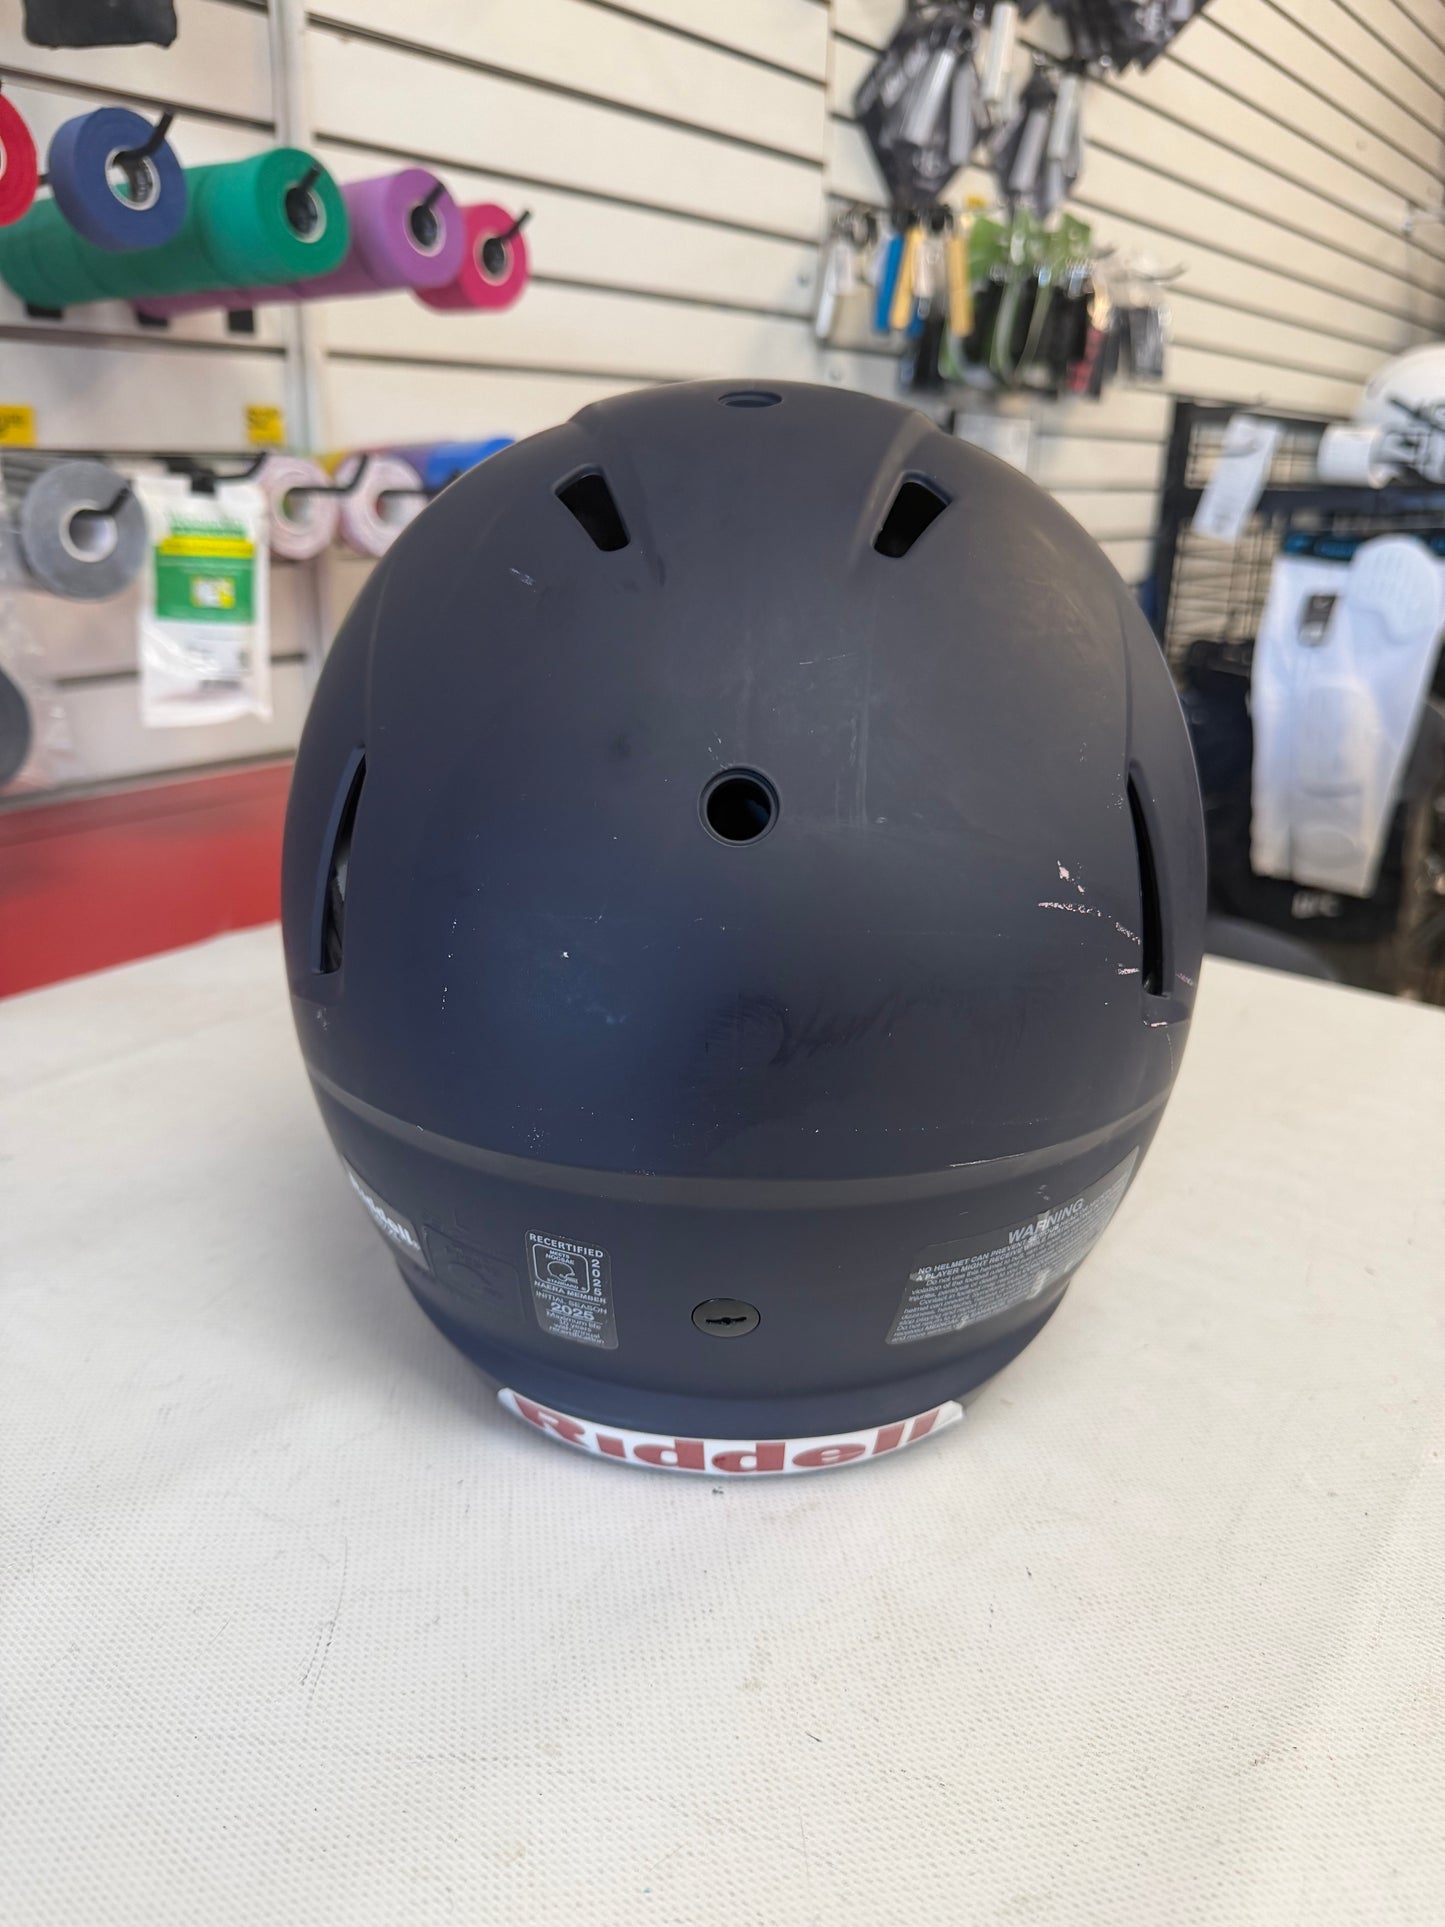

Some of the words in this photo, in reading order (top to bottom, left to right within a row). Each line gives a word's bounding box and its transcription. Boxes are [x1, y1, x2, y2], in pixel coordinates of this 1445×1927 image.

[1008, 1198, 1085, 1245] WARNING
[529, 1232, 604, 1259] RECERTIFIED
[917, 1266, 932, 1275] NO
[934, 1258, 970, 1272] HELMET
[971, 1252, 990, 1263] CAN
[991, 1240, 1026, 1257] PREVENT
[924, 1268, 960, 1280] PLAYER
[961, 1260, 988, 1272] MIGHT
[989, 1248, 1023, 1264] RECEIVE
[550, 1301, 596, 1321] 2025
[567, 1290, 608, 1305] MEMBER
[568, 1299, 608, 1316] SEASON
[513, 1392, 941, 1473] Riddell
